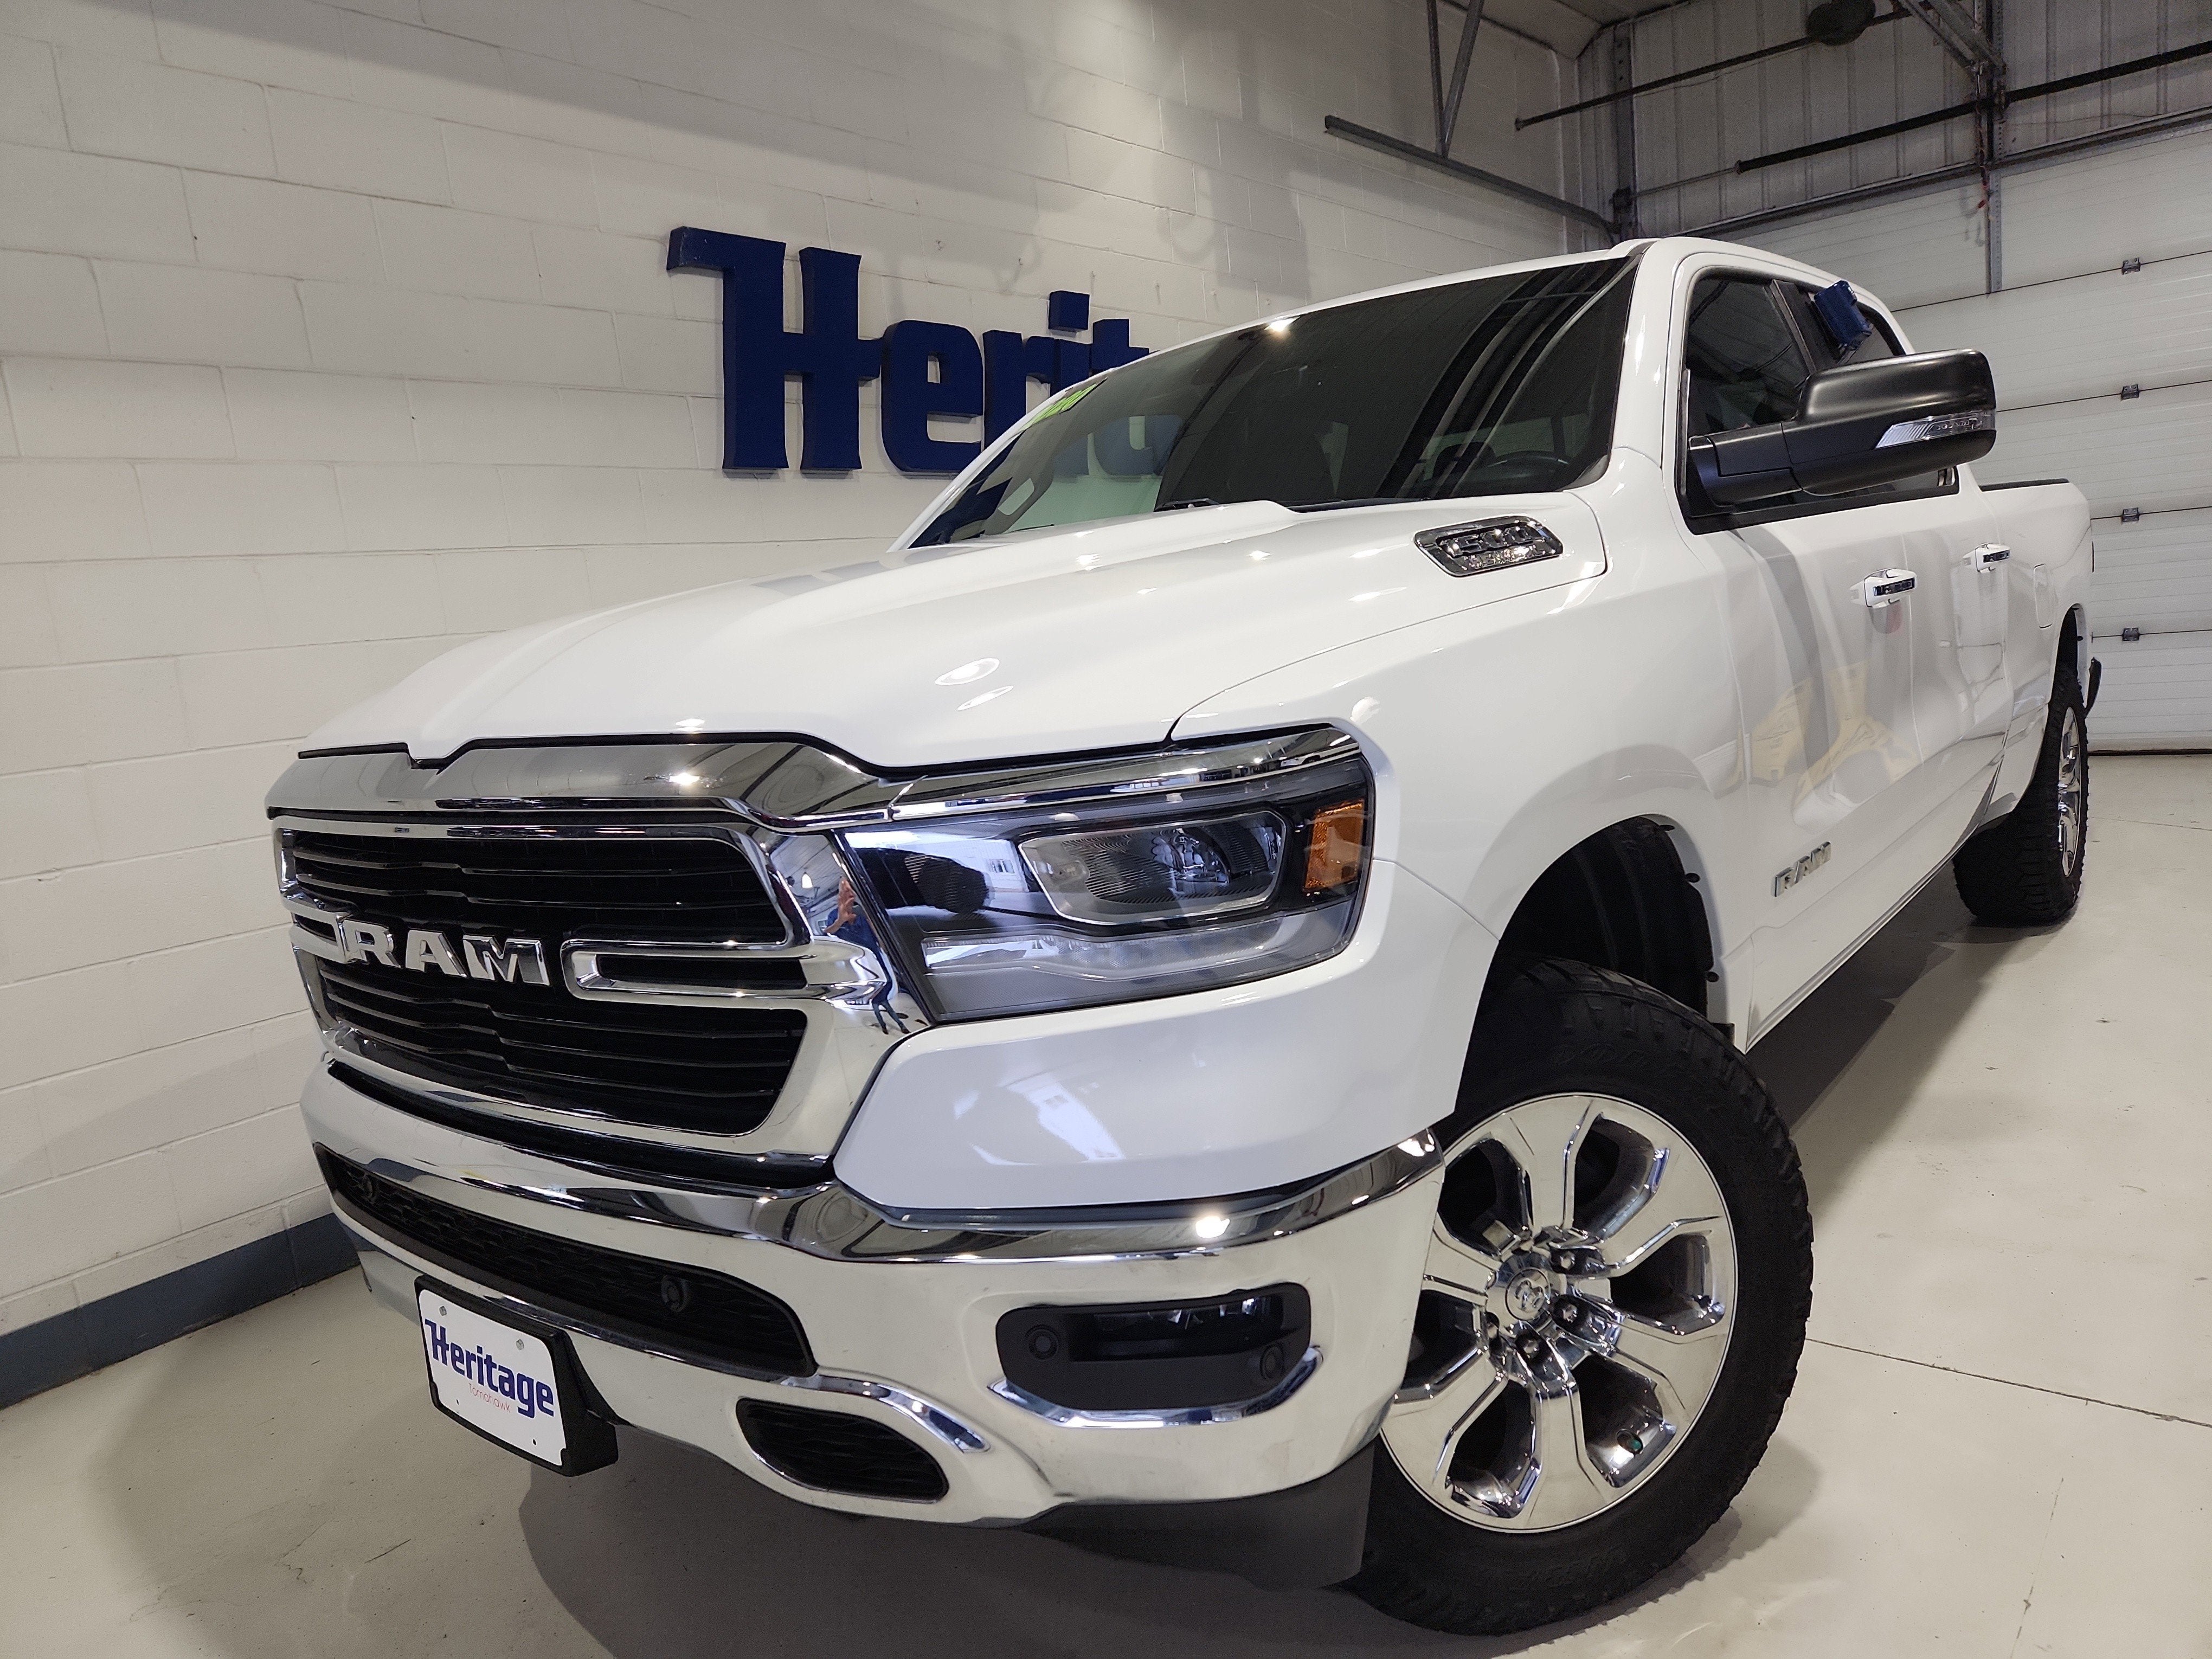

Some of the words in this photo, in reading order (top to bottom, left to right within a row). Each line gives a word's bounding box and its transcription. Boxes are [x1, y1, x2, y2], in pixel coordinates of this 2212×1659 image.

[1771, 841, 1831, 897] RAM
[337, 913, 550, 987] RAM
[425, 1319, 554, 1419] Heritage
[468, 1382, 511, 1413] Tomahawk
